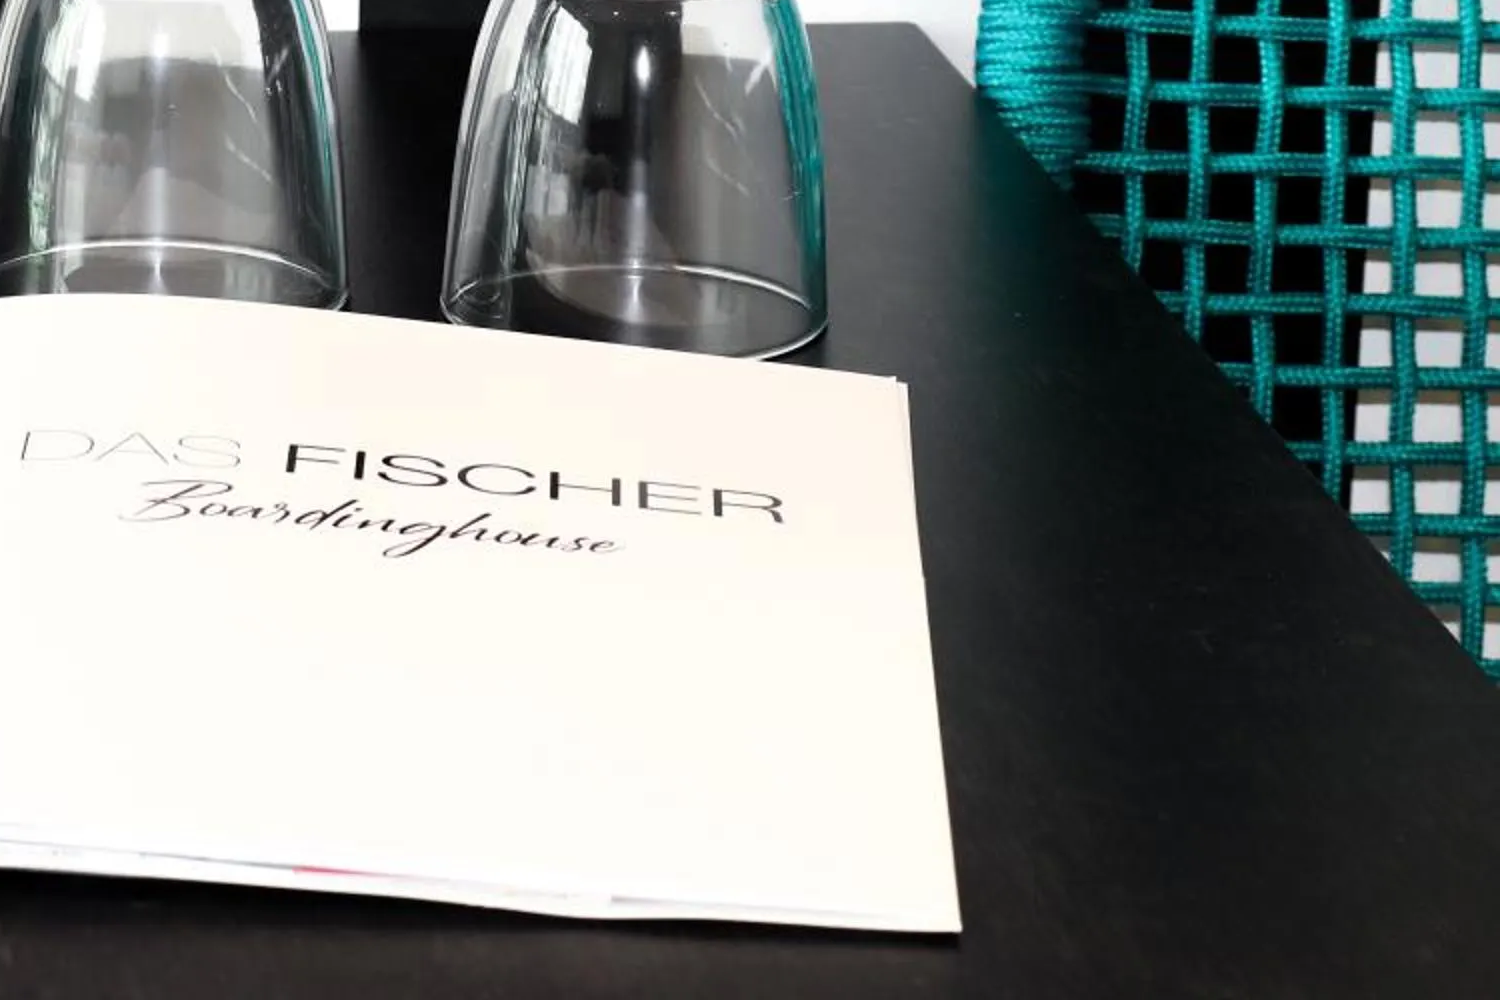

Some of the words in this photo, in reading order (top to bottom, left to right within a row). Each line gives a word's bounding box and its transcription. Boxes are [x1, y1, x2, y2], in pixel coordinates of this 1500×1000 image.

[19, 428, 242, 469] DAS
[284, 442, 786, 524] FISCHER
[117, 478, 626, 560] Boardinghouse
